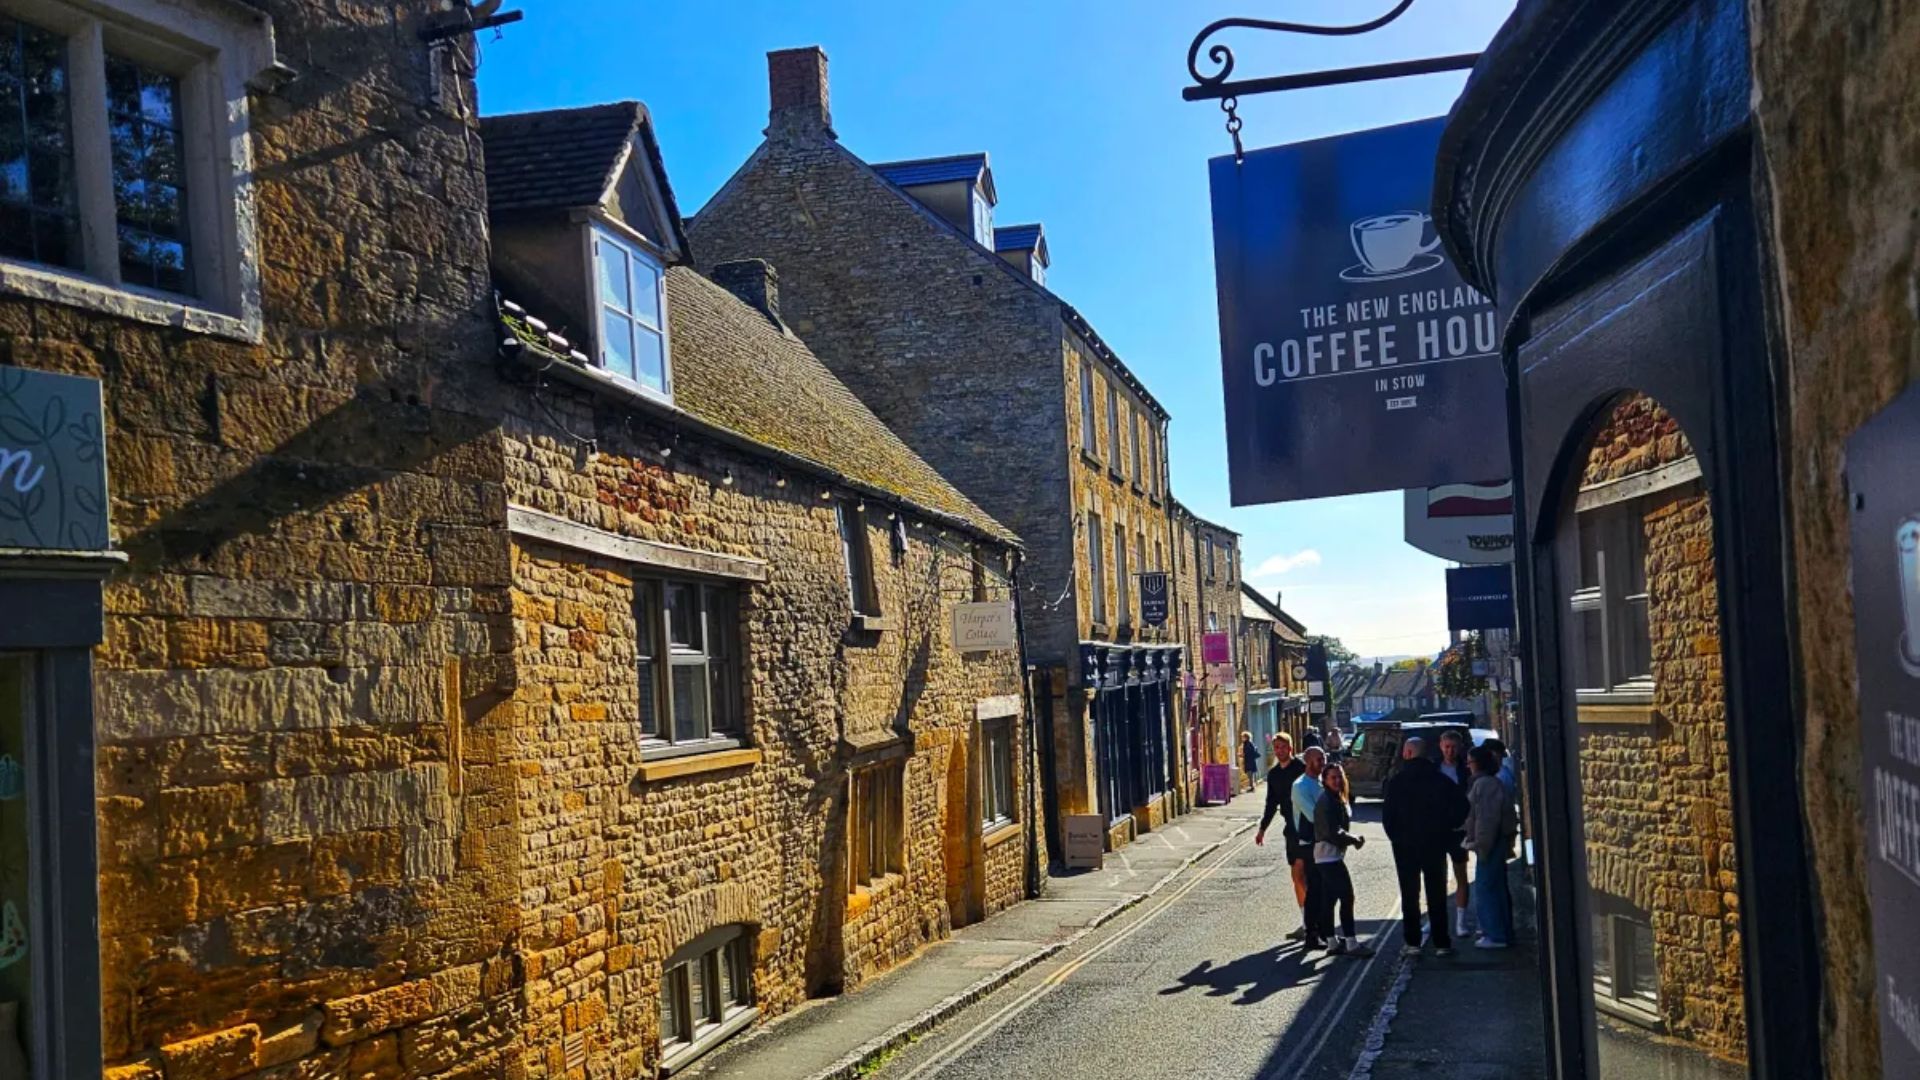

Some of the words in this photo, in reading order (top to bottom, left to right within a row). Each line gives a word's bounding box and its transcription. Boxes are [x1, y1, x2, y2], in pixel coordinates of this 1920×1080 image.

[1300, 304, 1338, 329] THE
[1346, 297, 1390, 323] NEW
[1253, 325, 1398, 388] COFFEE
[1375, 379, 1388, 392] IN
[1392, 374, 1426, 390] STOW
